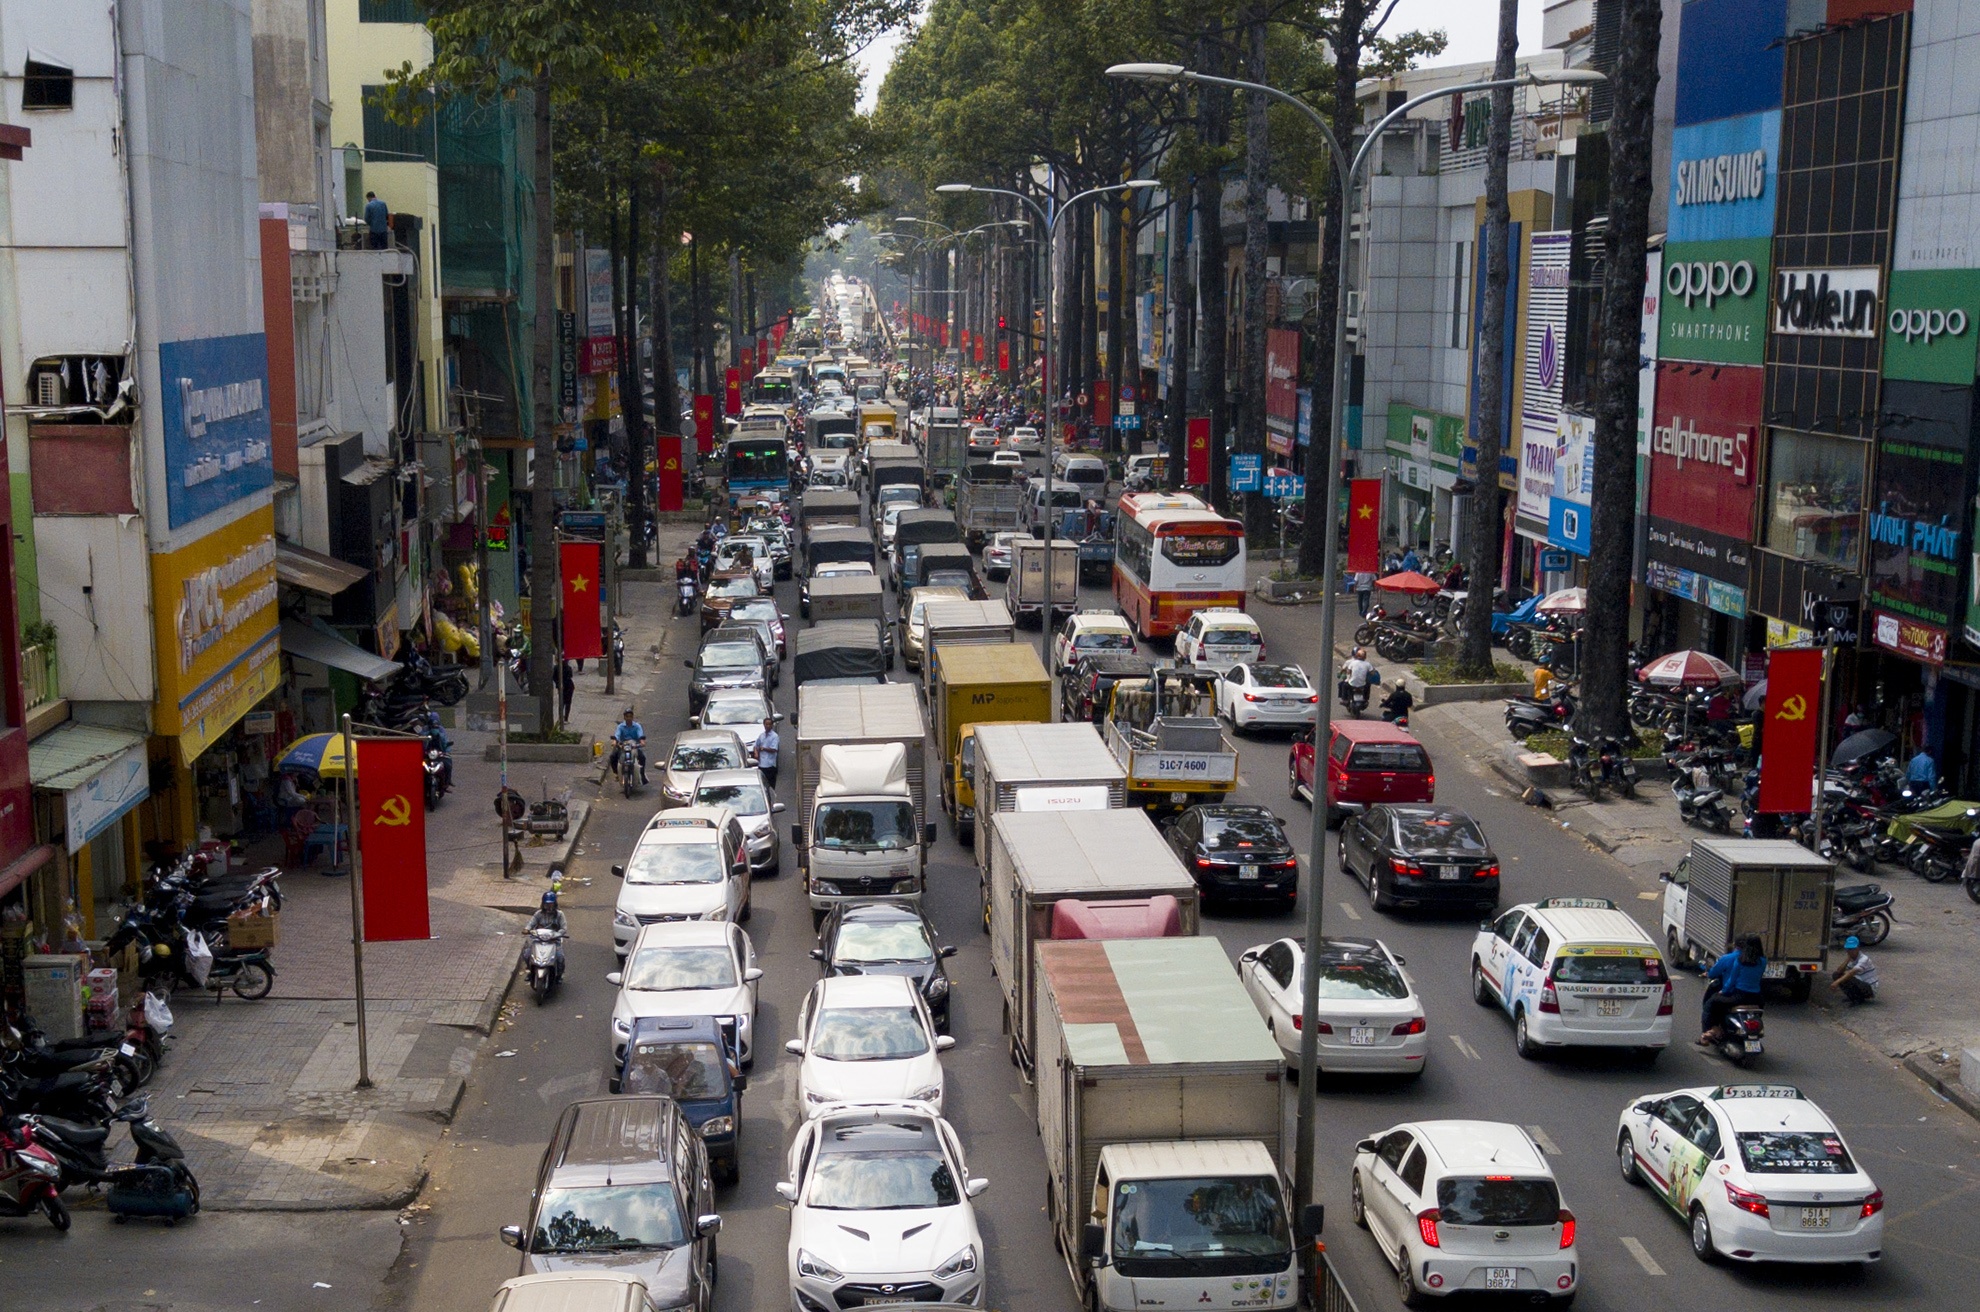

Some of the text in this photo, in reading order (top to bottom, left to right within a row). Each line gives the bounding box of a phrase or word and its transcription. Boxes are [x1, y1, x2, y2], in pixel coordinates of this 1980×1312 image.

[1676, 150, 1766, 206] SAMSUNG
[1670, 322, 1751, 343] SMARTPHONE
[972, 693, 995, 705] MP
[1769, 1090, 1781, 1098] 27
[1783, 1090, 1795, 1098] 27
[1808, 1208, 1824, 1218] 51A
[1493, 1269, 1510, 1279] 60A
